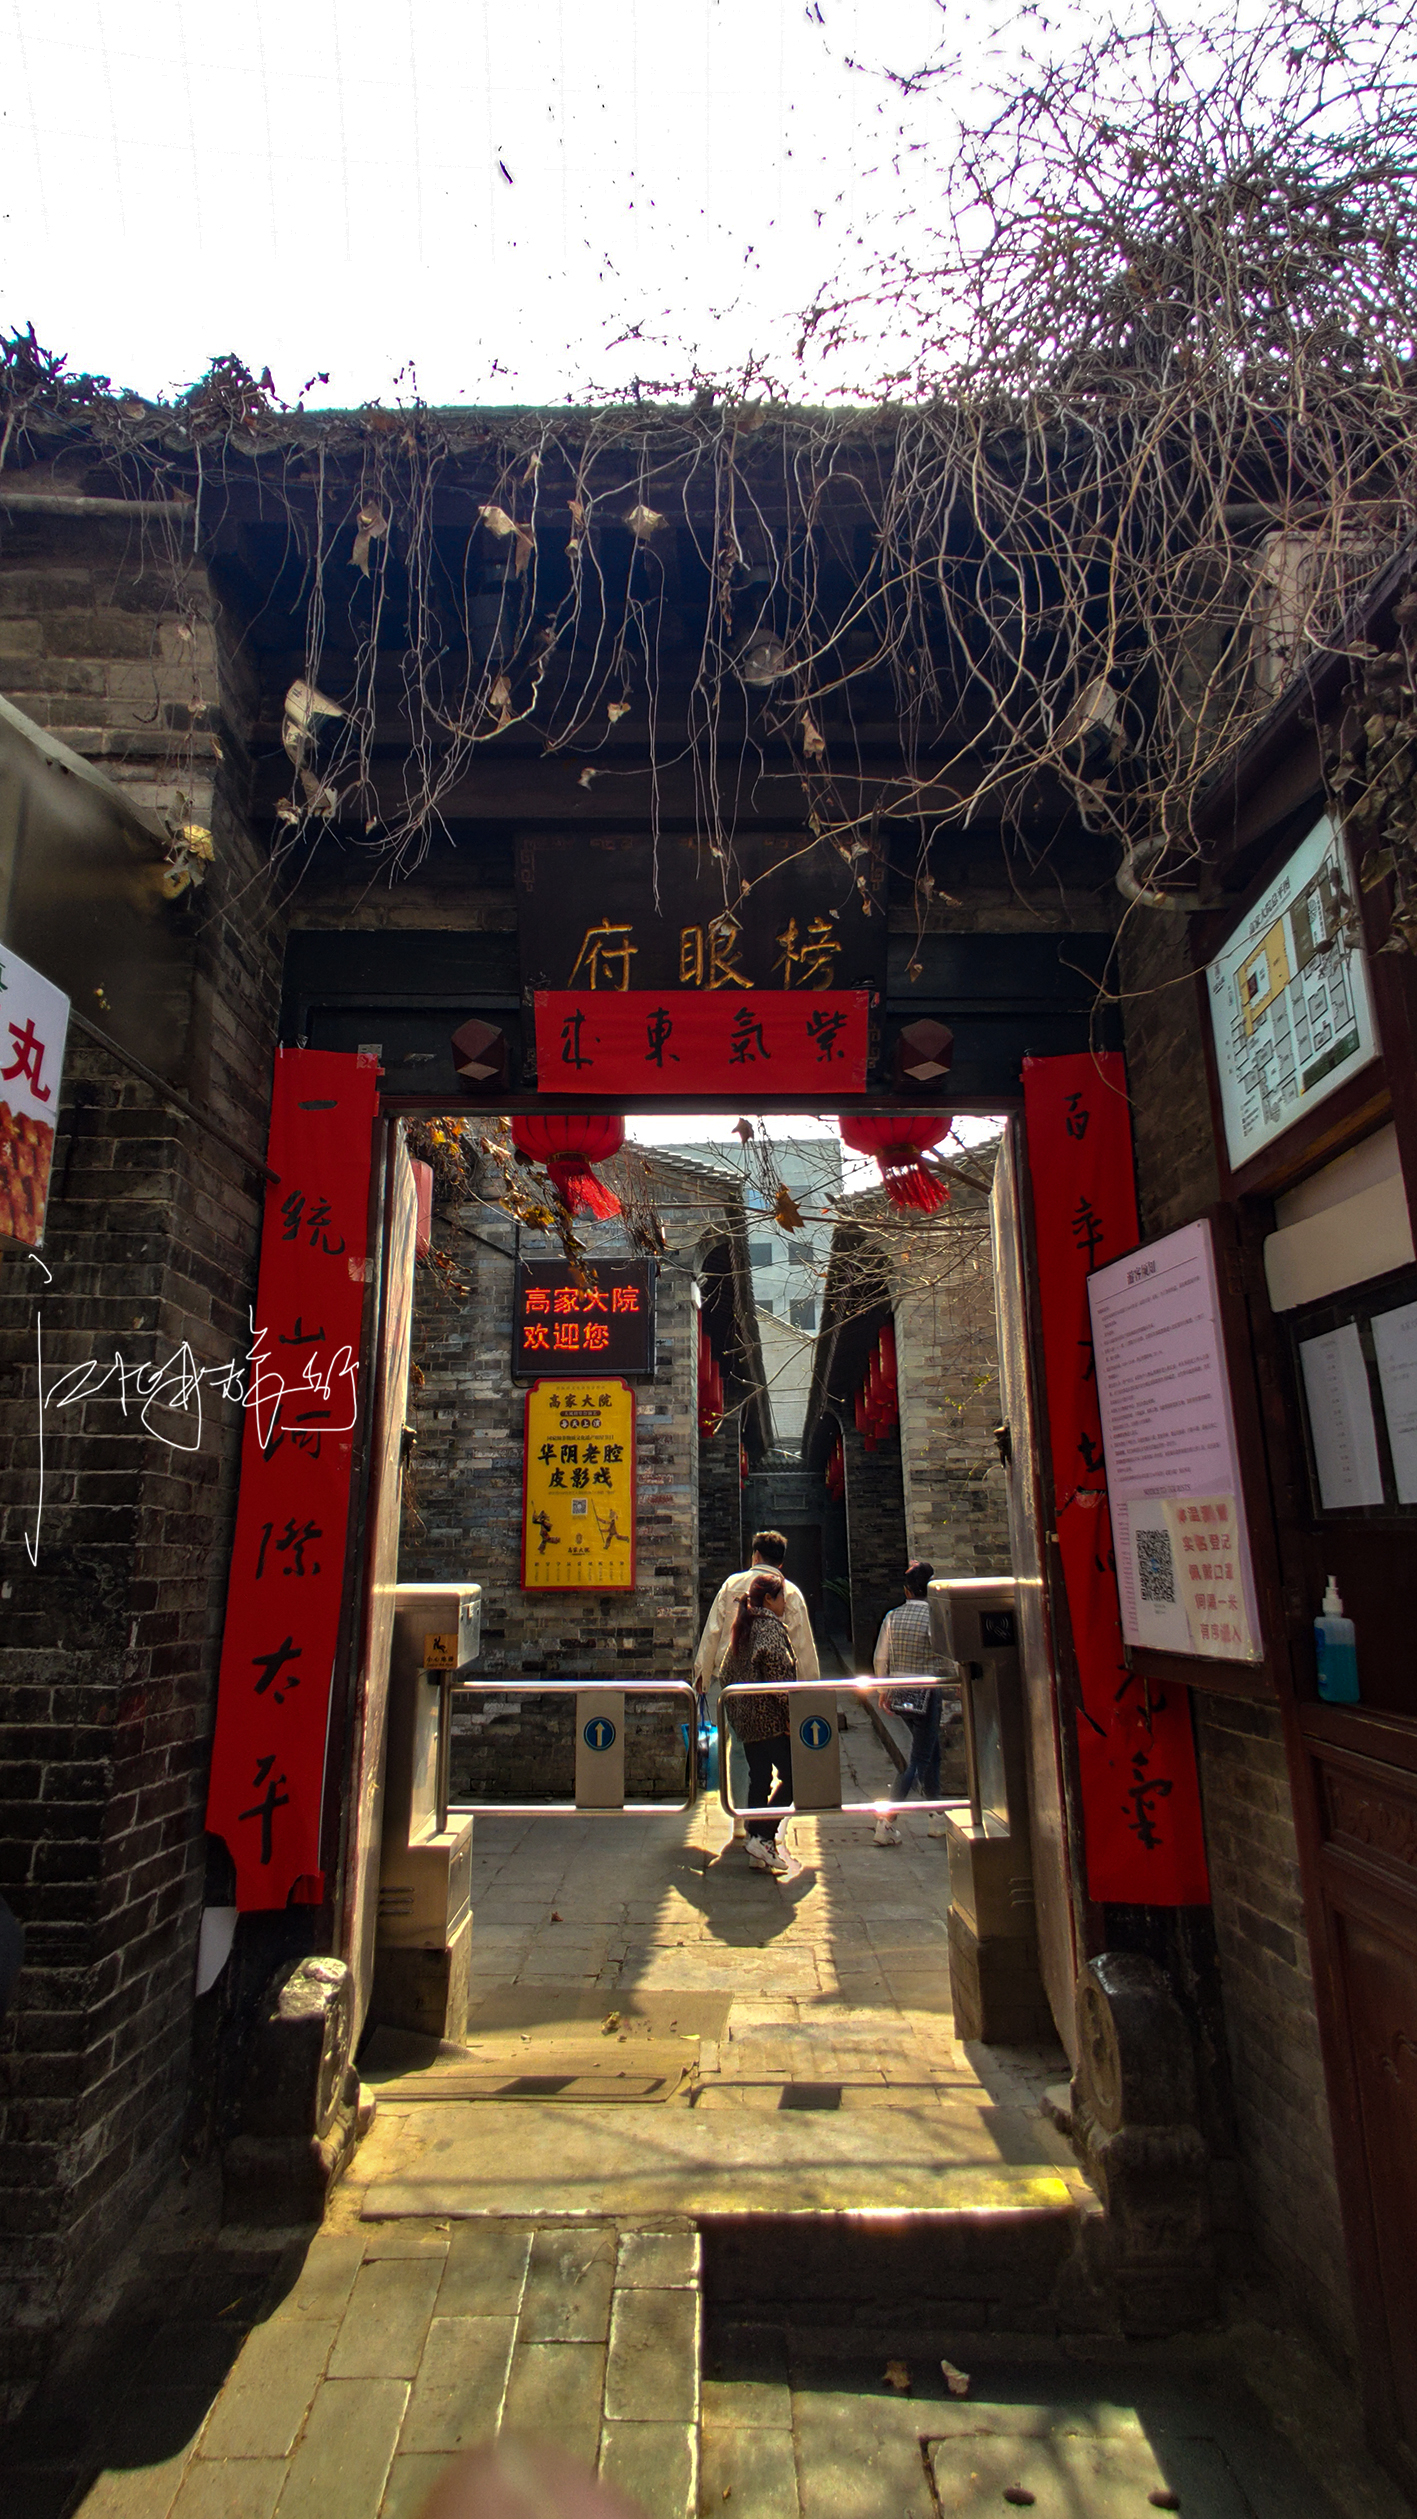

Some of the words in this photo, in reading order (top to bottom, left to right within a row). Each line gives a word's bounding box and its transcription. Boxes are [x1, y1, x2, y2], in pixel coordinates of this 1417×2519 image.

[0, 1018, 51, 1102] 丸
[525, 1286, 640, 1314] 高家大院
[523, 1323, 610, 1350] 欢迎您
[549, 1393, 612, 1408] 高家大院
[538, 1443, 624, 1466] 华阴老腔
[548, 1467, 613, 1489] 皮影戏
